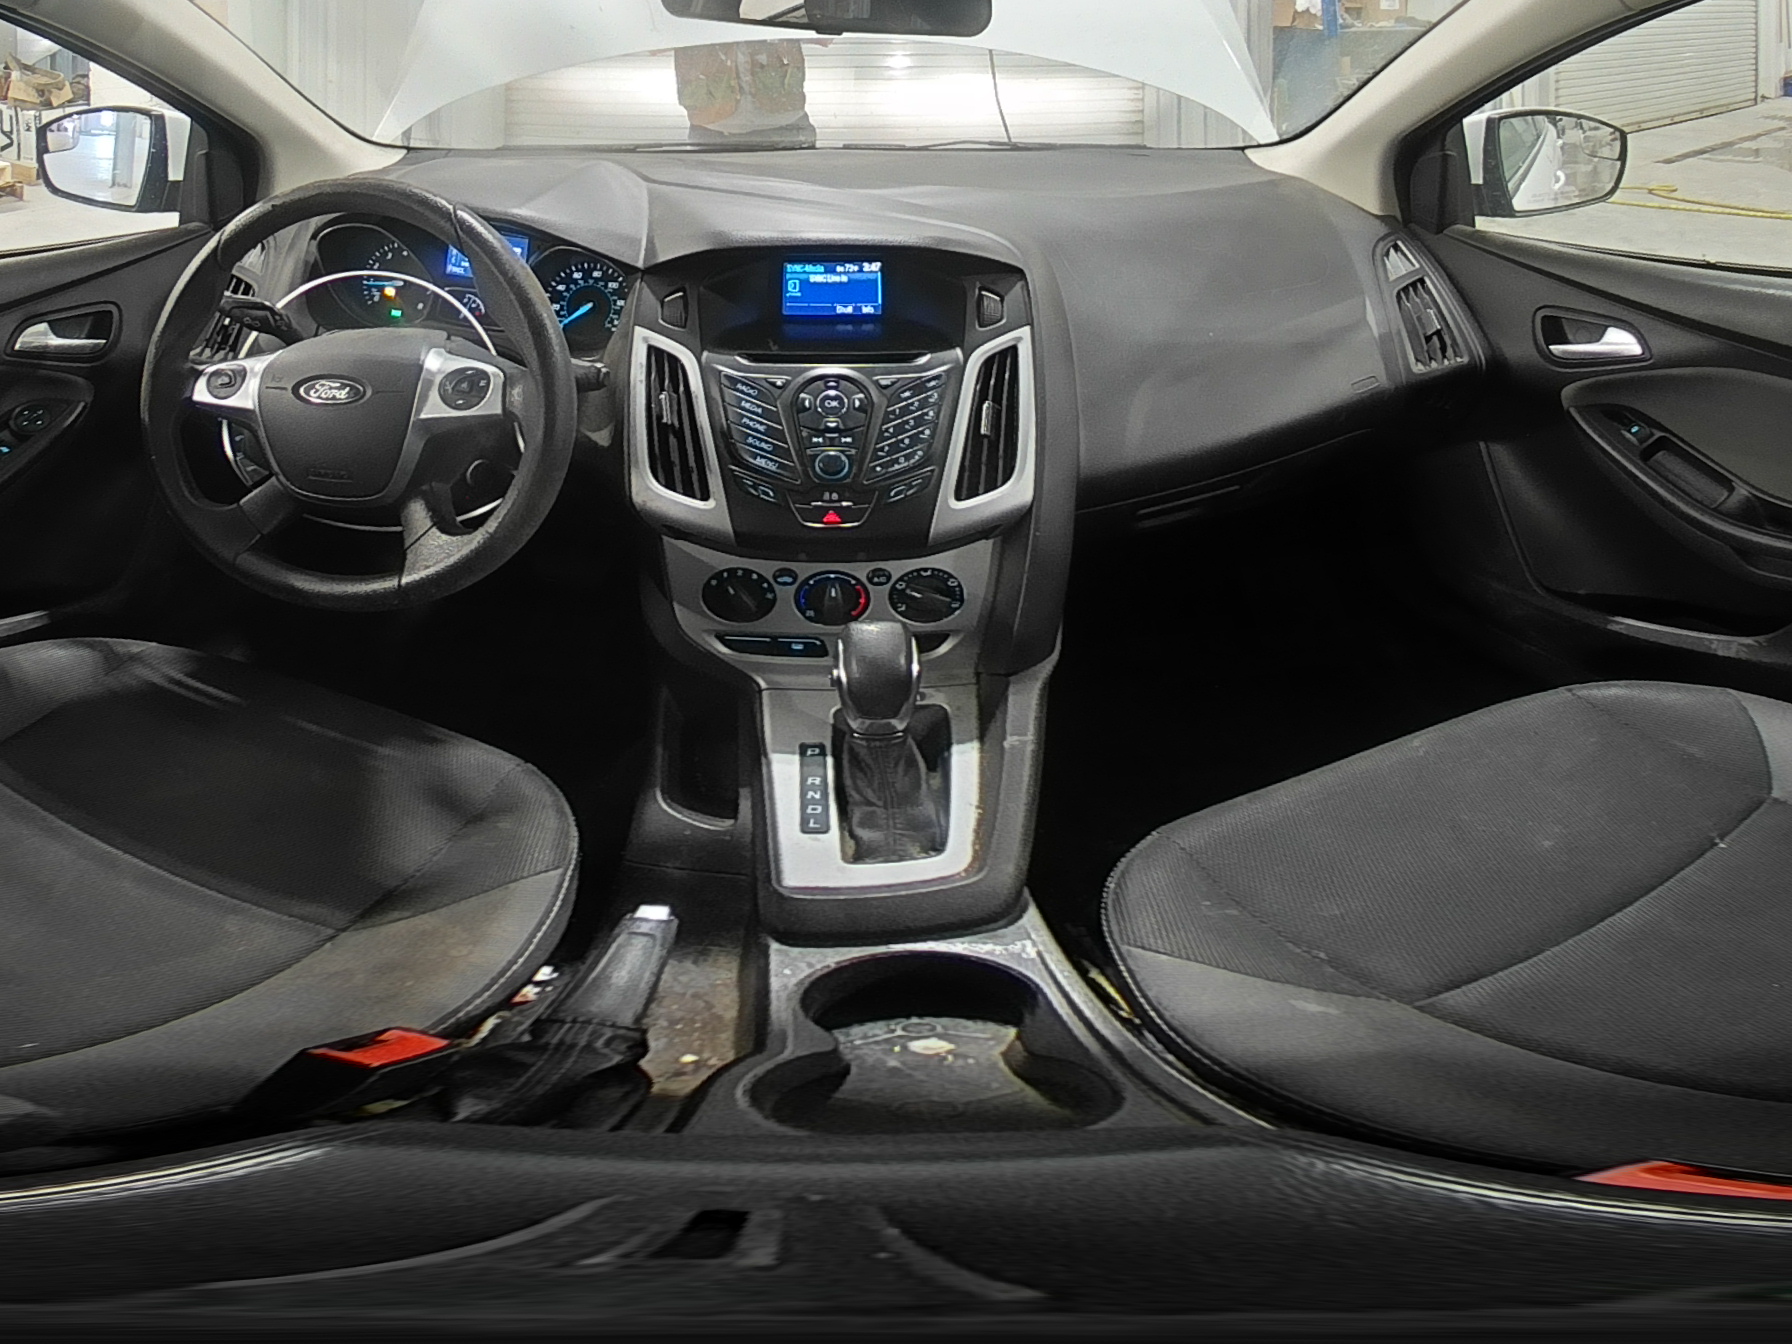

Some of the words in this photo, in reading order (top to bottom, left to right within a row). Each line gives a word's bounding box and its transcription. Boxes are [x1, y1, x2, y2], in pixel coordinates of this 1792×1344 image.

[310, 381, 350, 399] Ford
[735, 383, 758, 396] RADIO
[740, 400, 763, 414] MEDIA
[824, 399, 841, 408] OK
[741, 417, 768, 432] PHONE
[746, 436, 774, 451] SOUND
[806, 747, 820, 756] P
[805, 777, 822, 785] R
[805, 790, 821, 799] N
[805, 805, 823, 814] D
[808, 818, 821, 828] L
